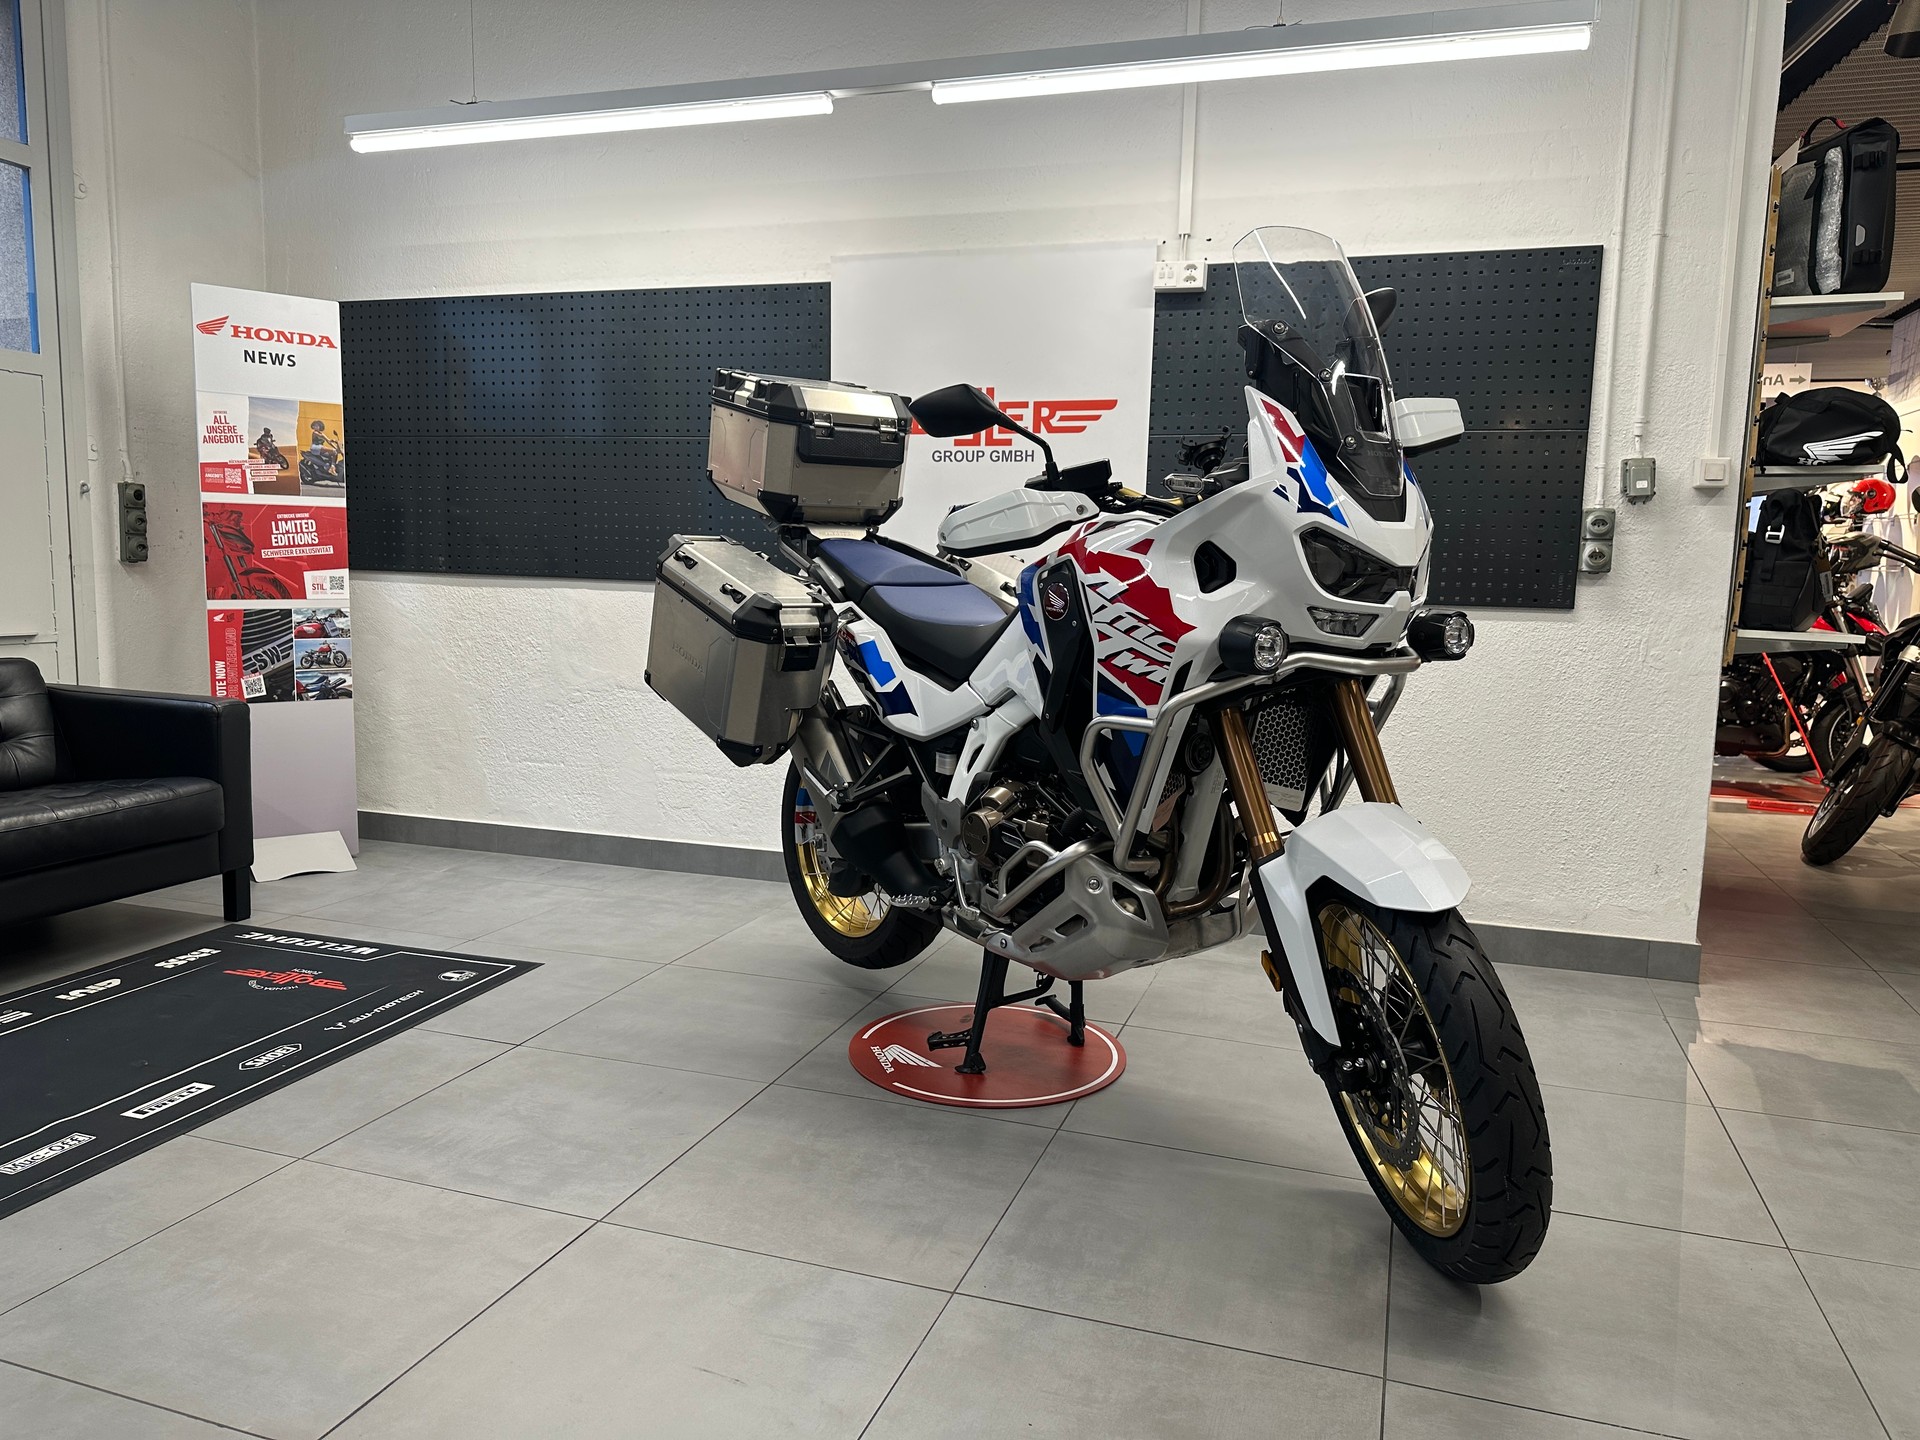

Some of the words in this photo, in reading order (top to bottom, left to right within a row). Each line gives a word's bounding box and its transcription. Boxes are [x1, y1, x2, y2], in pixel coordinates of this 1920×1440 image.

[230, 325, 338, 349] HONDA
[243, 349, 297, 367] NEWS
[213, 415, 230, 425] ALL
[206, 425, 238, 434] UNSERE
[202, 434, 245, 444] ANGEBOTE
[931, 450, 985, 463] GROUP
[989, 450, 1035, 463] GMBH
[271, 519, 317, 534] LIMITED
[271, 533, 319, 547] EDITIONS
[262, 549, 294, 557] SCHWEIZER
[225, 627, 239, 684] SWITZERLAND
[215, 660, 226, 679] NOW
[215, 680, 227, 697] OTE
[234, 931, 380, 955] WELCOME
[245, 1045, 298, 1068] SHOEI
[870, 1045, 895, 1074] HONDA
